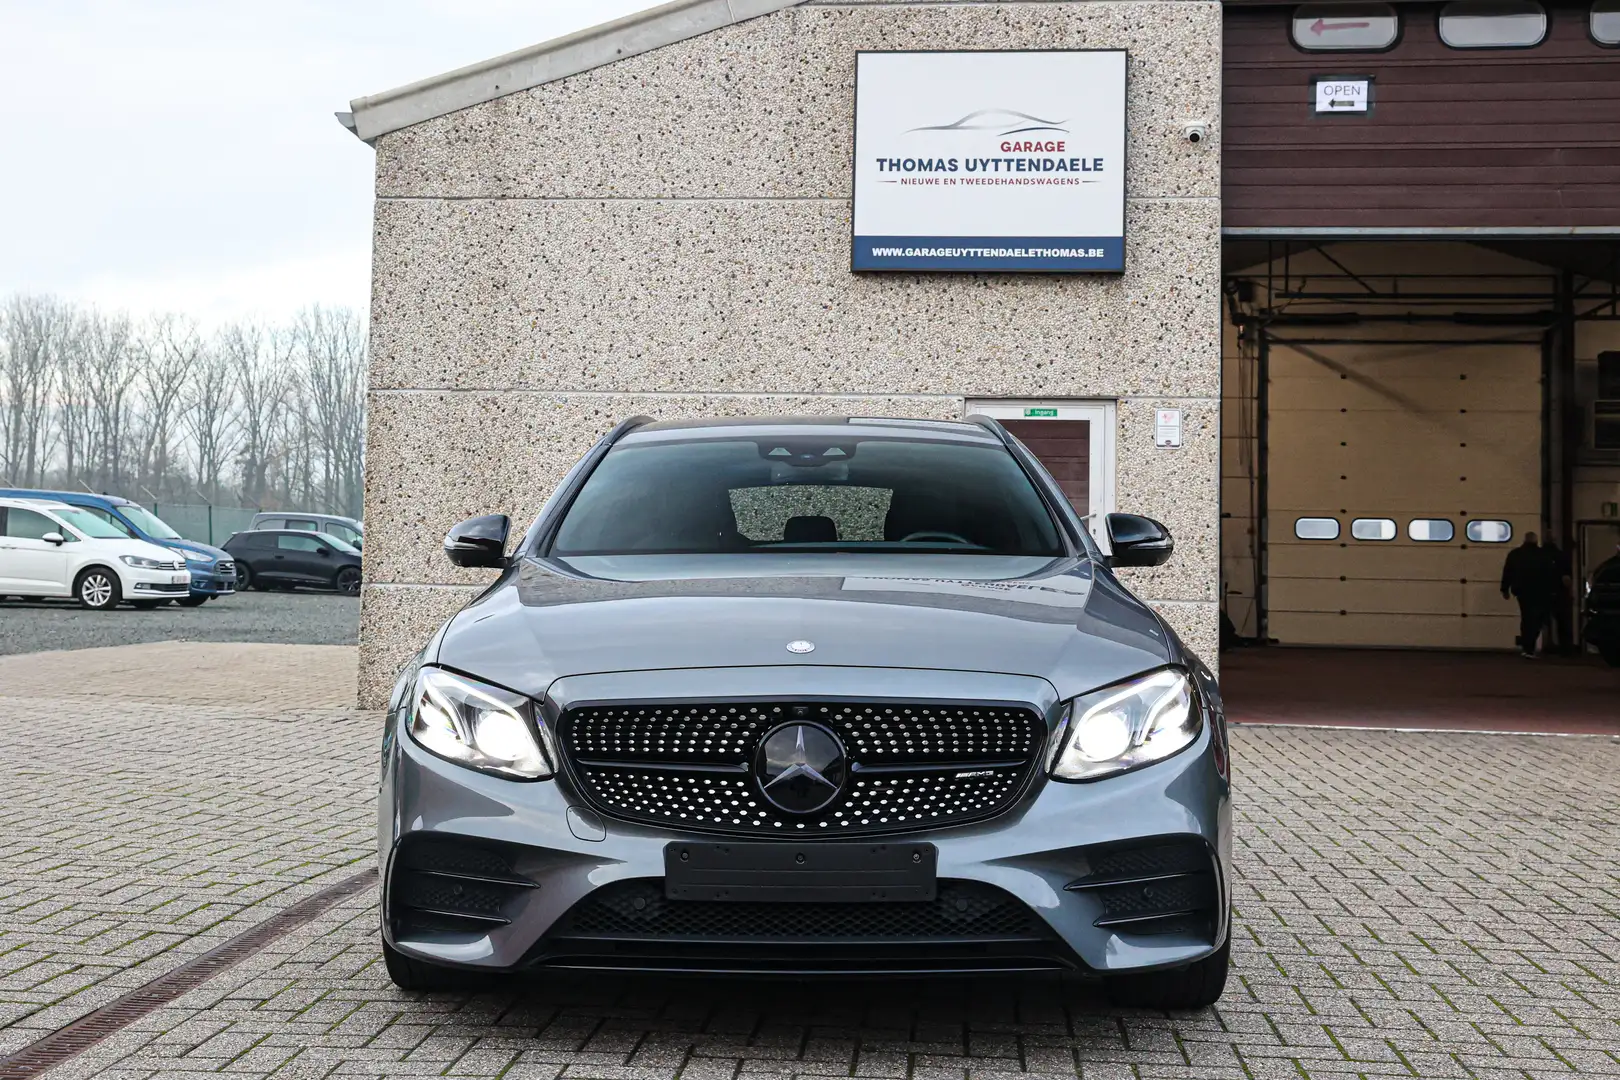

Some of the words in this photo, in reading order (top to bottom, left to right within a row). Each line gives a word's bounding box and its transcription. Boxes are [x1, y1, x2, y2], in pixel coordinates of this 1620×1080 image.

[1323, 85, 1361, 96] OPEN
[1000, 141, 1066, 153] GARAGE
[876, 158, 958, 172] THOMAS
[966, 158, 1104, 172] UYTTENDAELE
[872, 247, 1104, 258] WWW.GARAGEUYTTENDAELETHOMAS.BE
